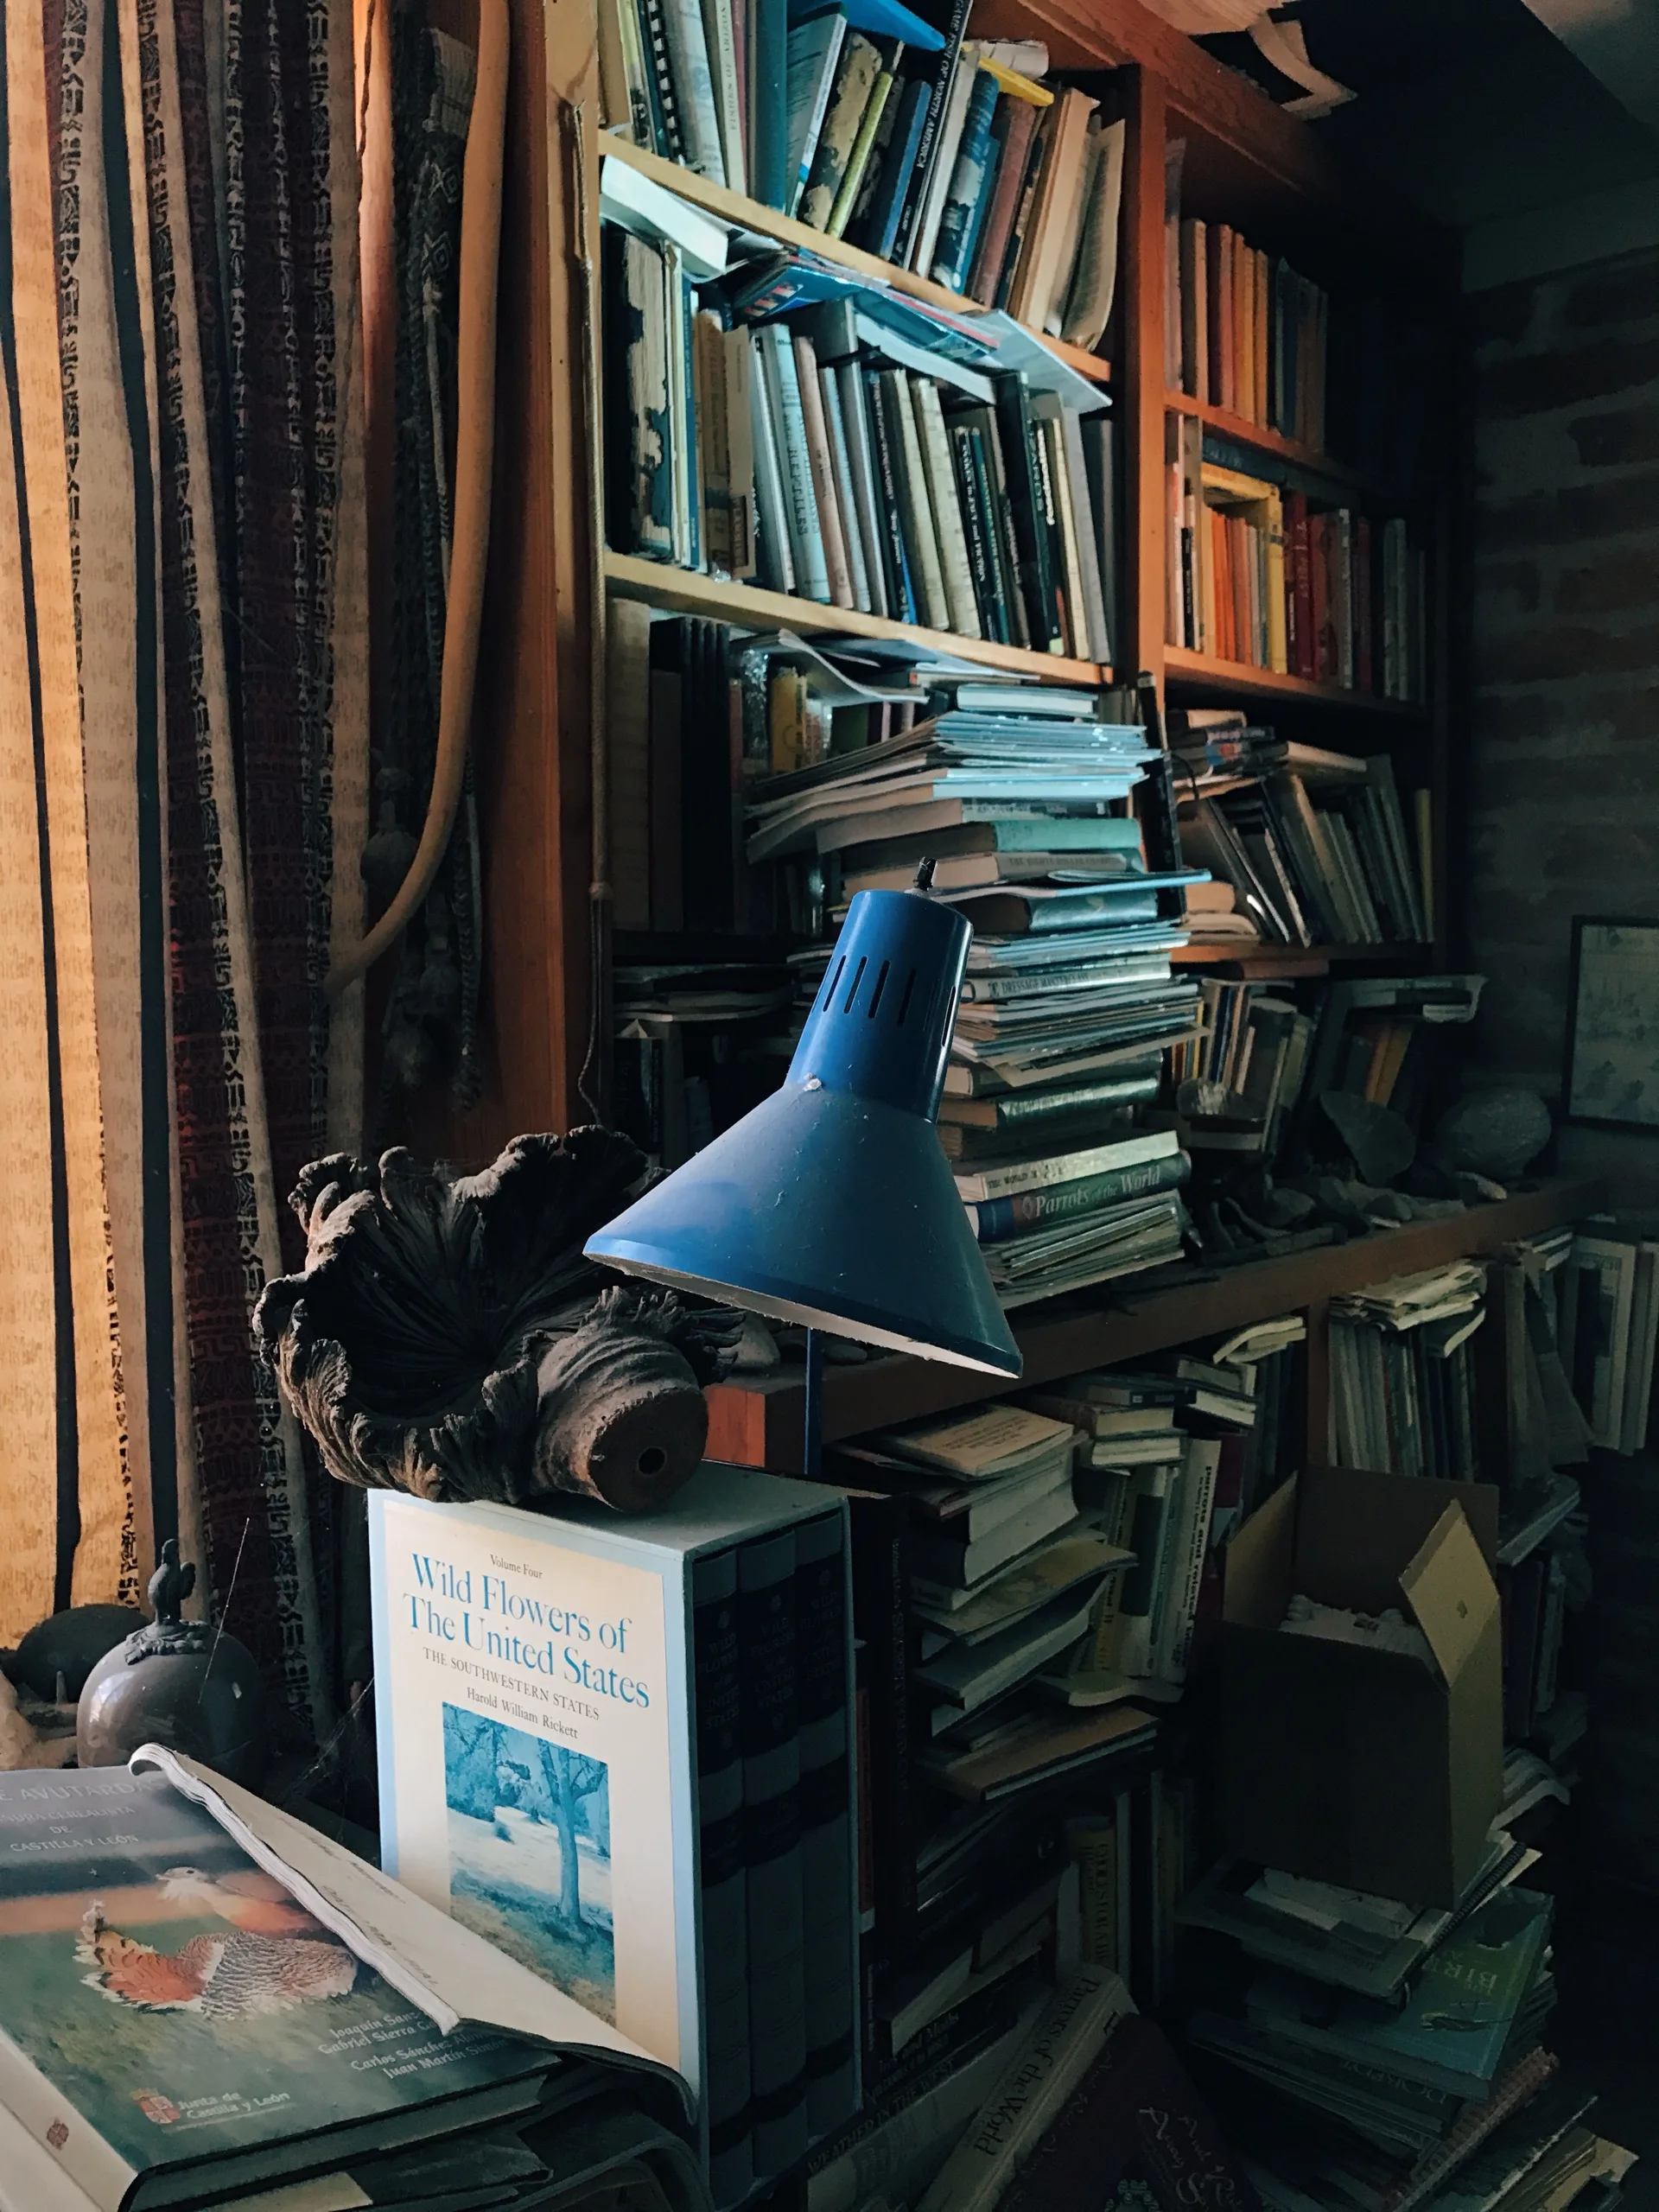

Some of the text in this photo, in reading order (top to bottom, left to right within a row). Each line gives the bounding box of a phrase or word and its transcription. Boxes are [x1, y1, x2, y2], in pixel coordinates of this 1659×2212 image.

[941, 61, 951, 79] OF
[931, 77, 947, 118] NORTH
[916, 117, 938, 168] AMERICA
[1001, 978, 1039, 994] DRESSAGE
[1035, 1187, 1090, 1218] Parrots
[1102, 1182, 1118, 1195] the
[1120, 1165, 1161, 1194] World
[1200, 1465, 1211, 1522] parrots
[1195, 1529, 1204, 1559] and
[490, 1554, 543, 1580] Volume Four
[411, 1553, 632, 1654] Wild Flowers of
[1187, 1565, 1199, 1620] related
[403, 1592, 650, 1709] The United States
[422, 1646, 600, 1721] THE SOUTHWESTERN STATES
[467, 1686, 579, 1740] Harold William Rickett
[21, 1777, 166, 1802] AVUTARDAS
[48, 1806, 136, 1821] CEREALISTA
[10, 1832, 140, 1853] CASTILLA Y LEÓN
[48, 1825, 73, 1835] DE
[1049, 1976, 1103, 2037] Parrots
[318, 2034, 372, 2055] Gabriel
[372, 2024, 416, 2044] Sierra
[330, 2016, 383, 2040] Joaquín
[350, 2055, 396, 2071] Carlos
[397, 2039, 452, 2060] Sánchez
[382, 2062, 417, 2080] Juan
[418, 2050, 466, 2069] Martín
[1034, 2039, 1054, 2068] of
[1014, 2062, 1045, 2091] the
[178, 2091, 241, 2111] Junta de
[186, 2092, 290, 2120] Castilla y León
[973, 2094, 1028, 2156] World
